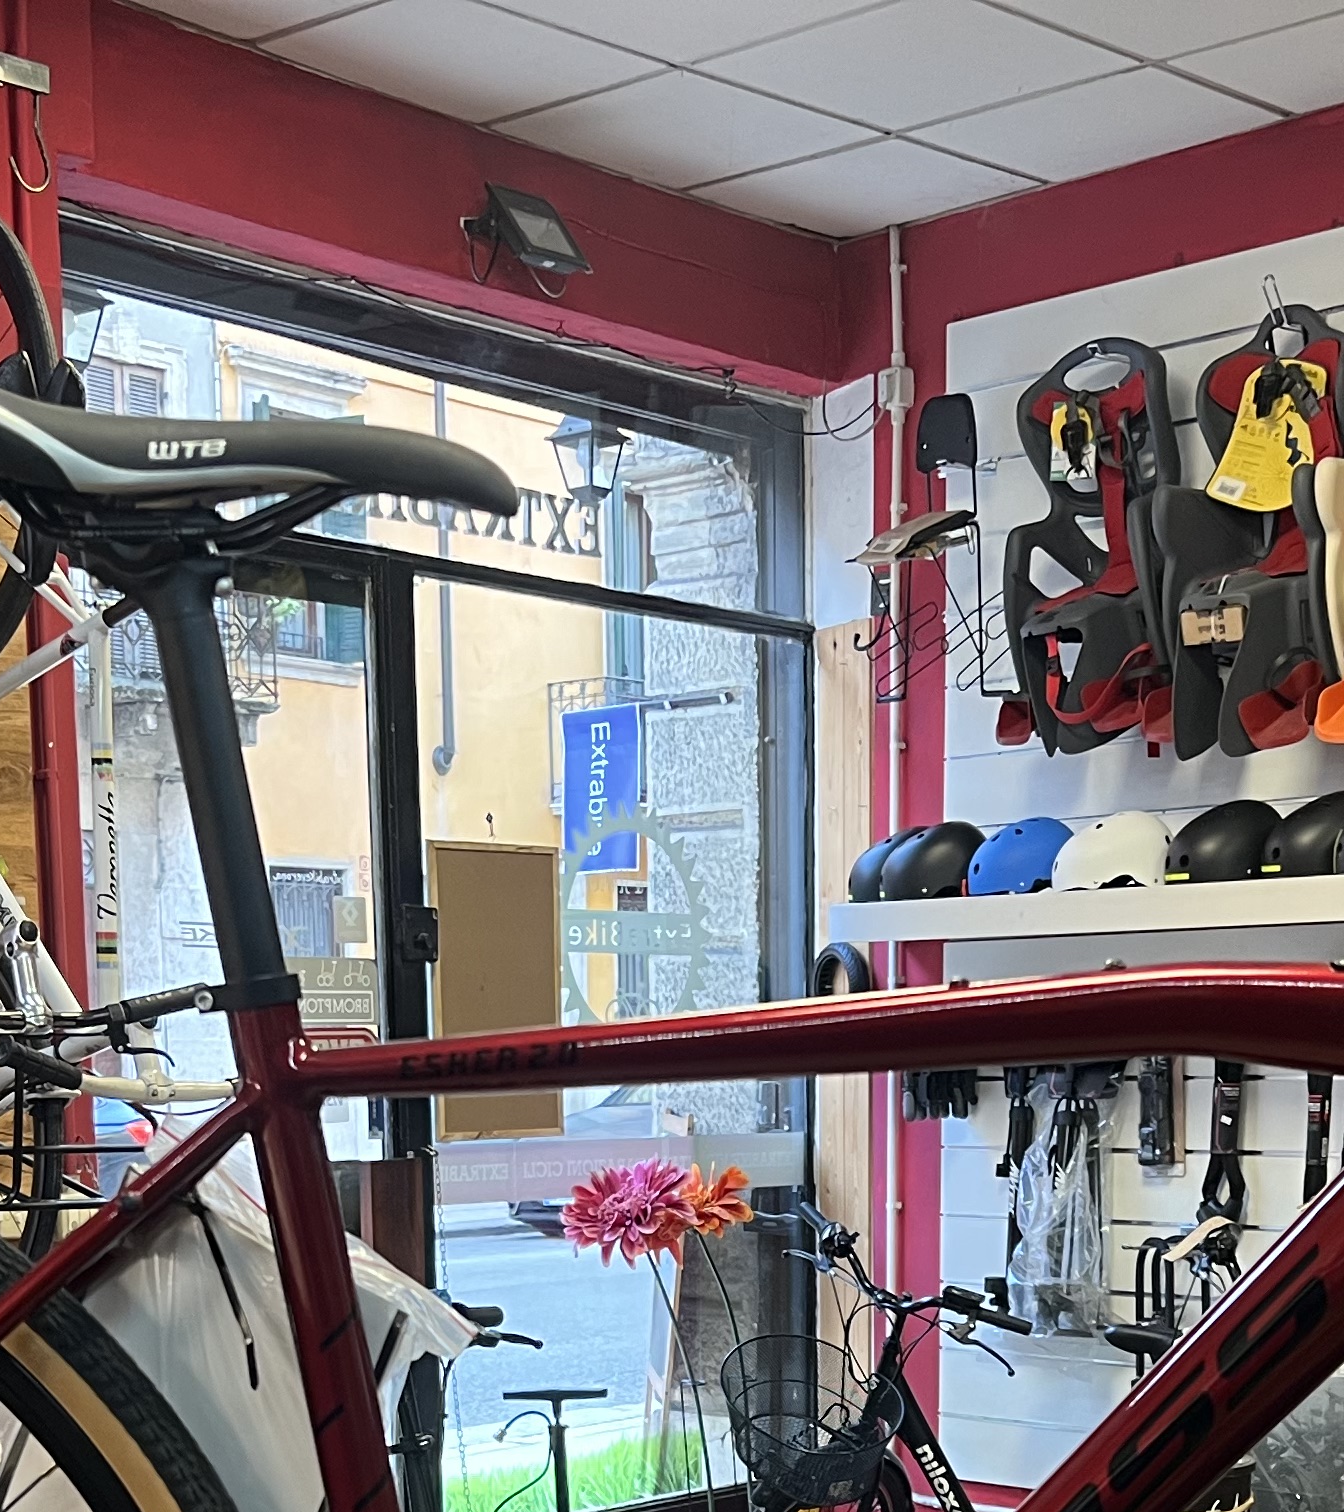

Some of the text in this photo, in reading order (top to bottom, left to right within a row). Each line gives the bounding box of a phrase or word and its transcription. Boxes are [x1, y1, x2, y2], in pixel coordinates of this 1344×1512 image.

[147, 438, 227, 461] WTB
[401, 1047, 518, 1079] ESHER
[914, 1443, 960, 1512] nilox
